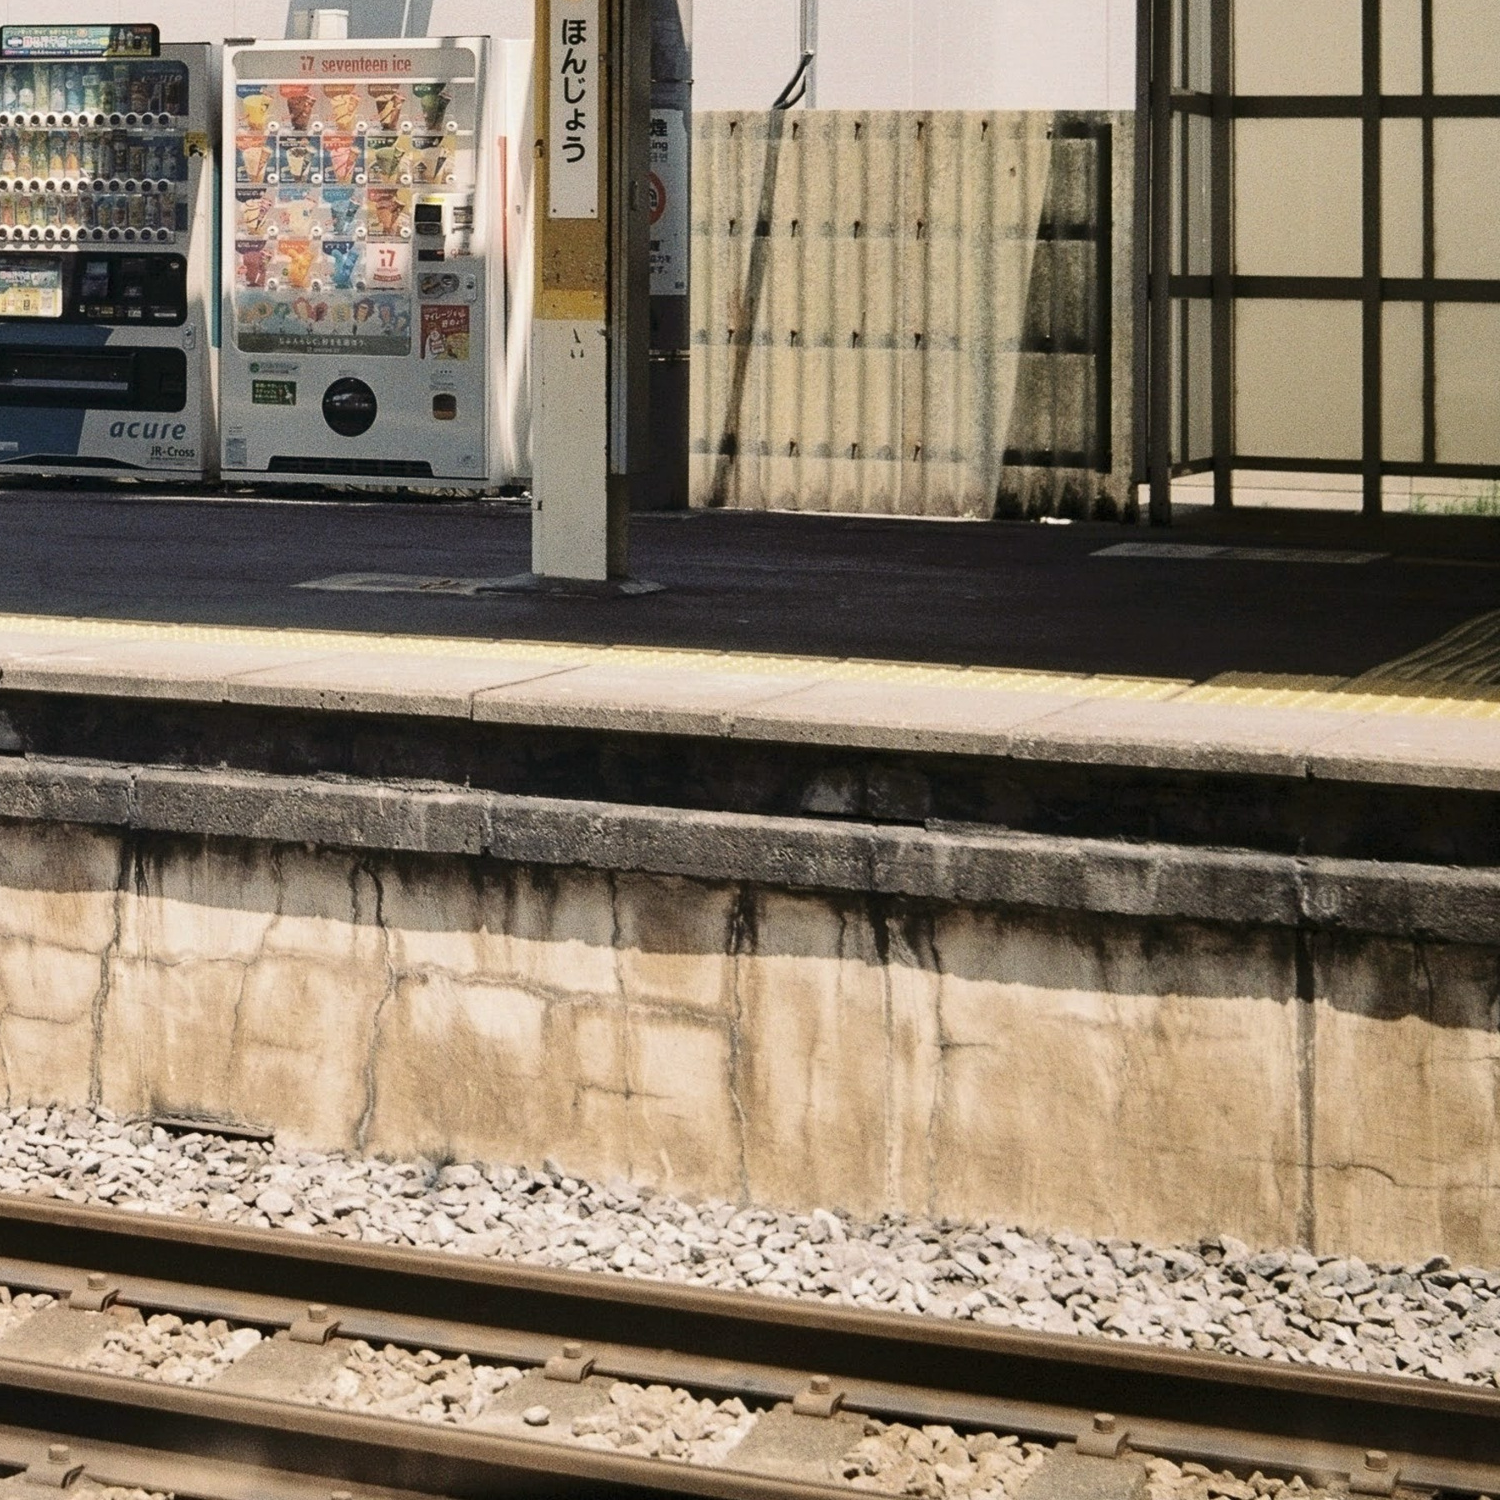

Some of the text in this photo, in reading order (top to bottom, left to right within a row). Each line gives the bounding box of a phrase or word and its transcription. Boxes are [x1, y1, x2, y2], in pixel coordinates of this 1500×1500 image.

[321, 56, 388, 72] seventeen
[393, 54, 412, 71] ice
[561, 18, 587, 163] ほんじょう
[109, 421, 187, 440] acure
[150, 446, 195, 457] JR-Cross
